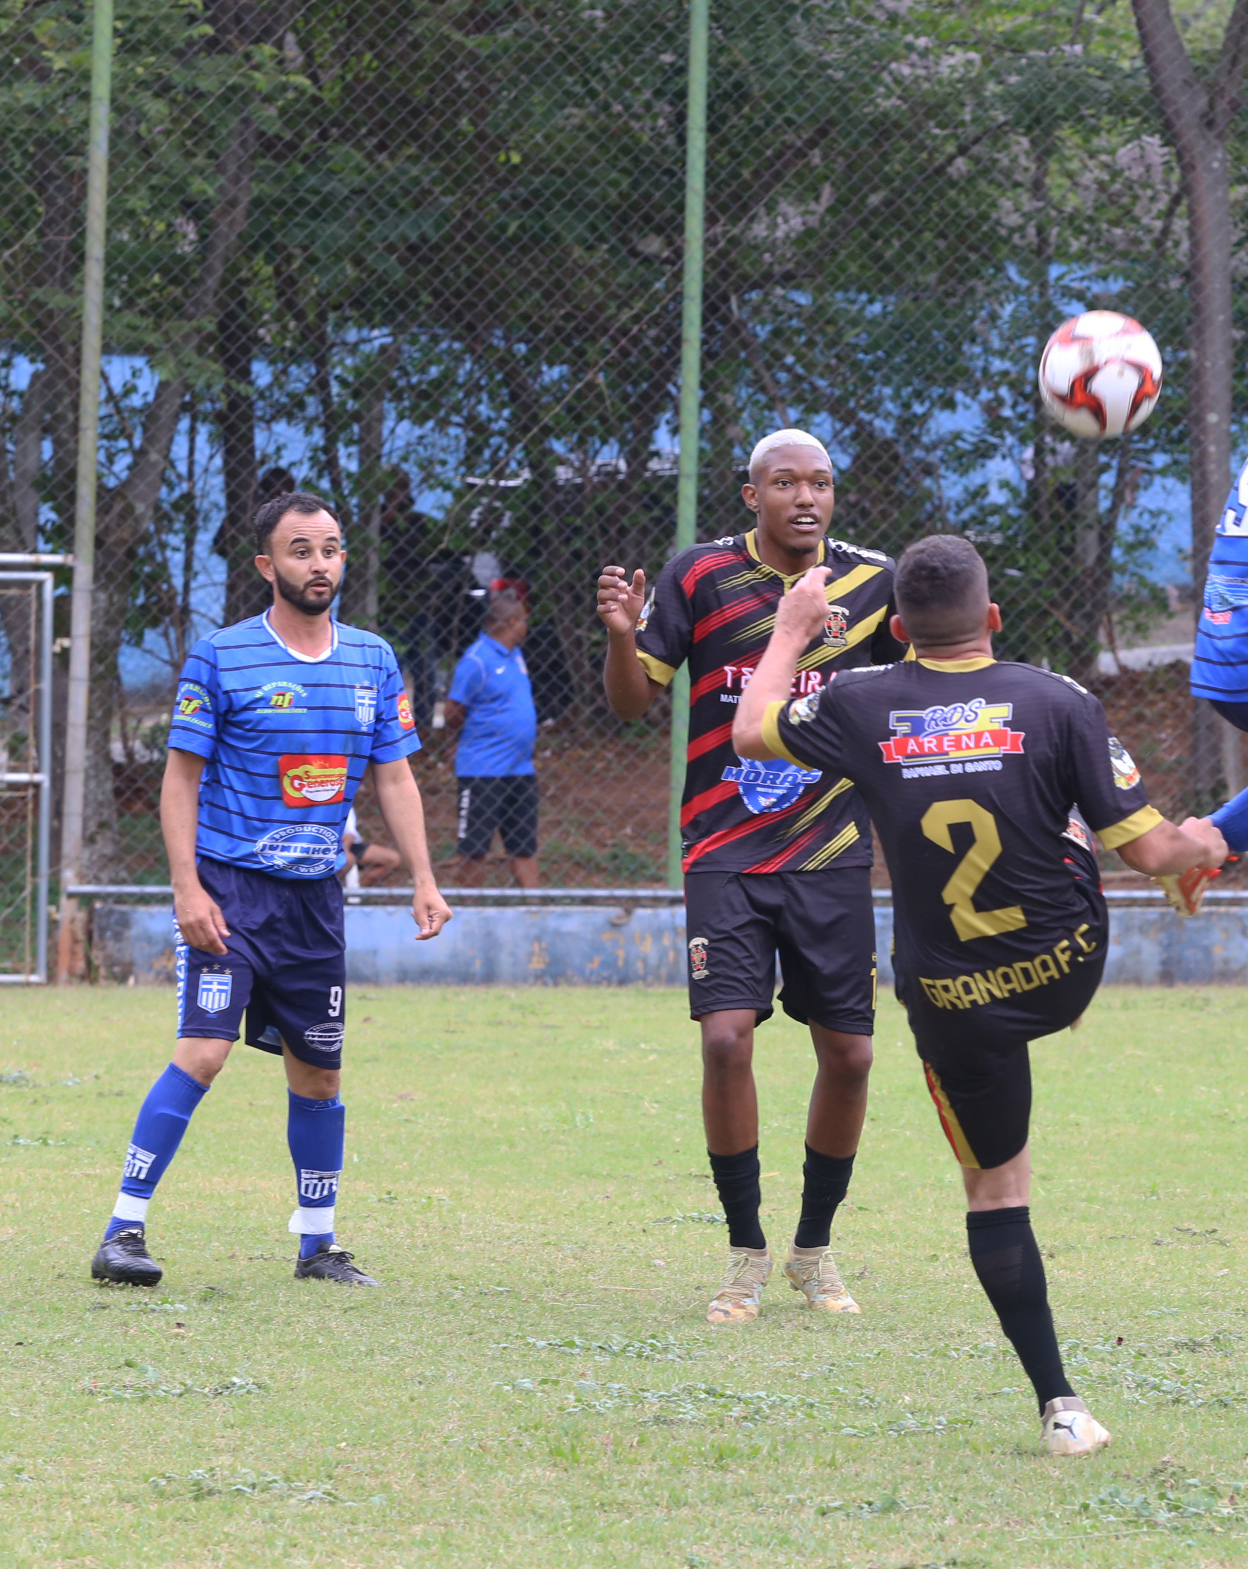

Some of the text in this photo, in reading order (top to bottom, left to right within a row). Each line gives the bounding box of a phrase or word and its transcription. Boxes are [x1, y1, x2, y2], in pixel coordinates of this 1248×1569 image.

[906, 730, 995, 755] ARENA
[721, 765, 823, 788] MORAS
[964, 759, 1003, 773] SANTO
[272, 826, 338, 842] PRODUCTION
[299, 863, 328, 873] WEAR
[920, 799, 1029, 942] 2
[918, 953, 1061, 1011] GRANADA
[327, 985, 343, 1018] 9
